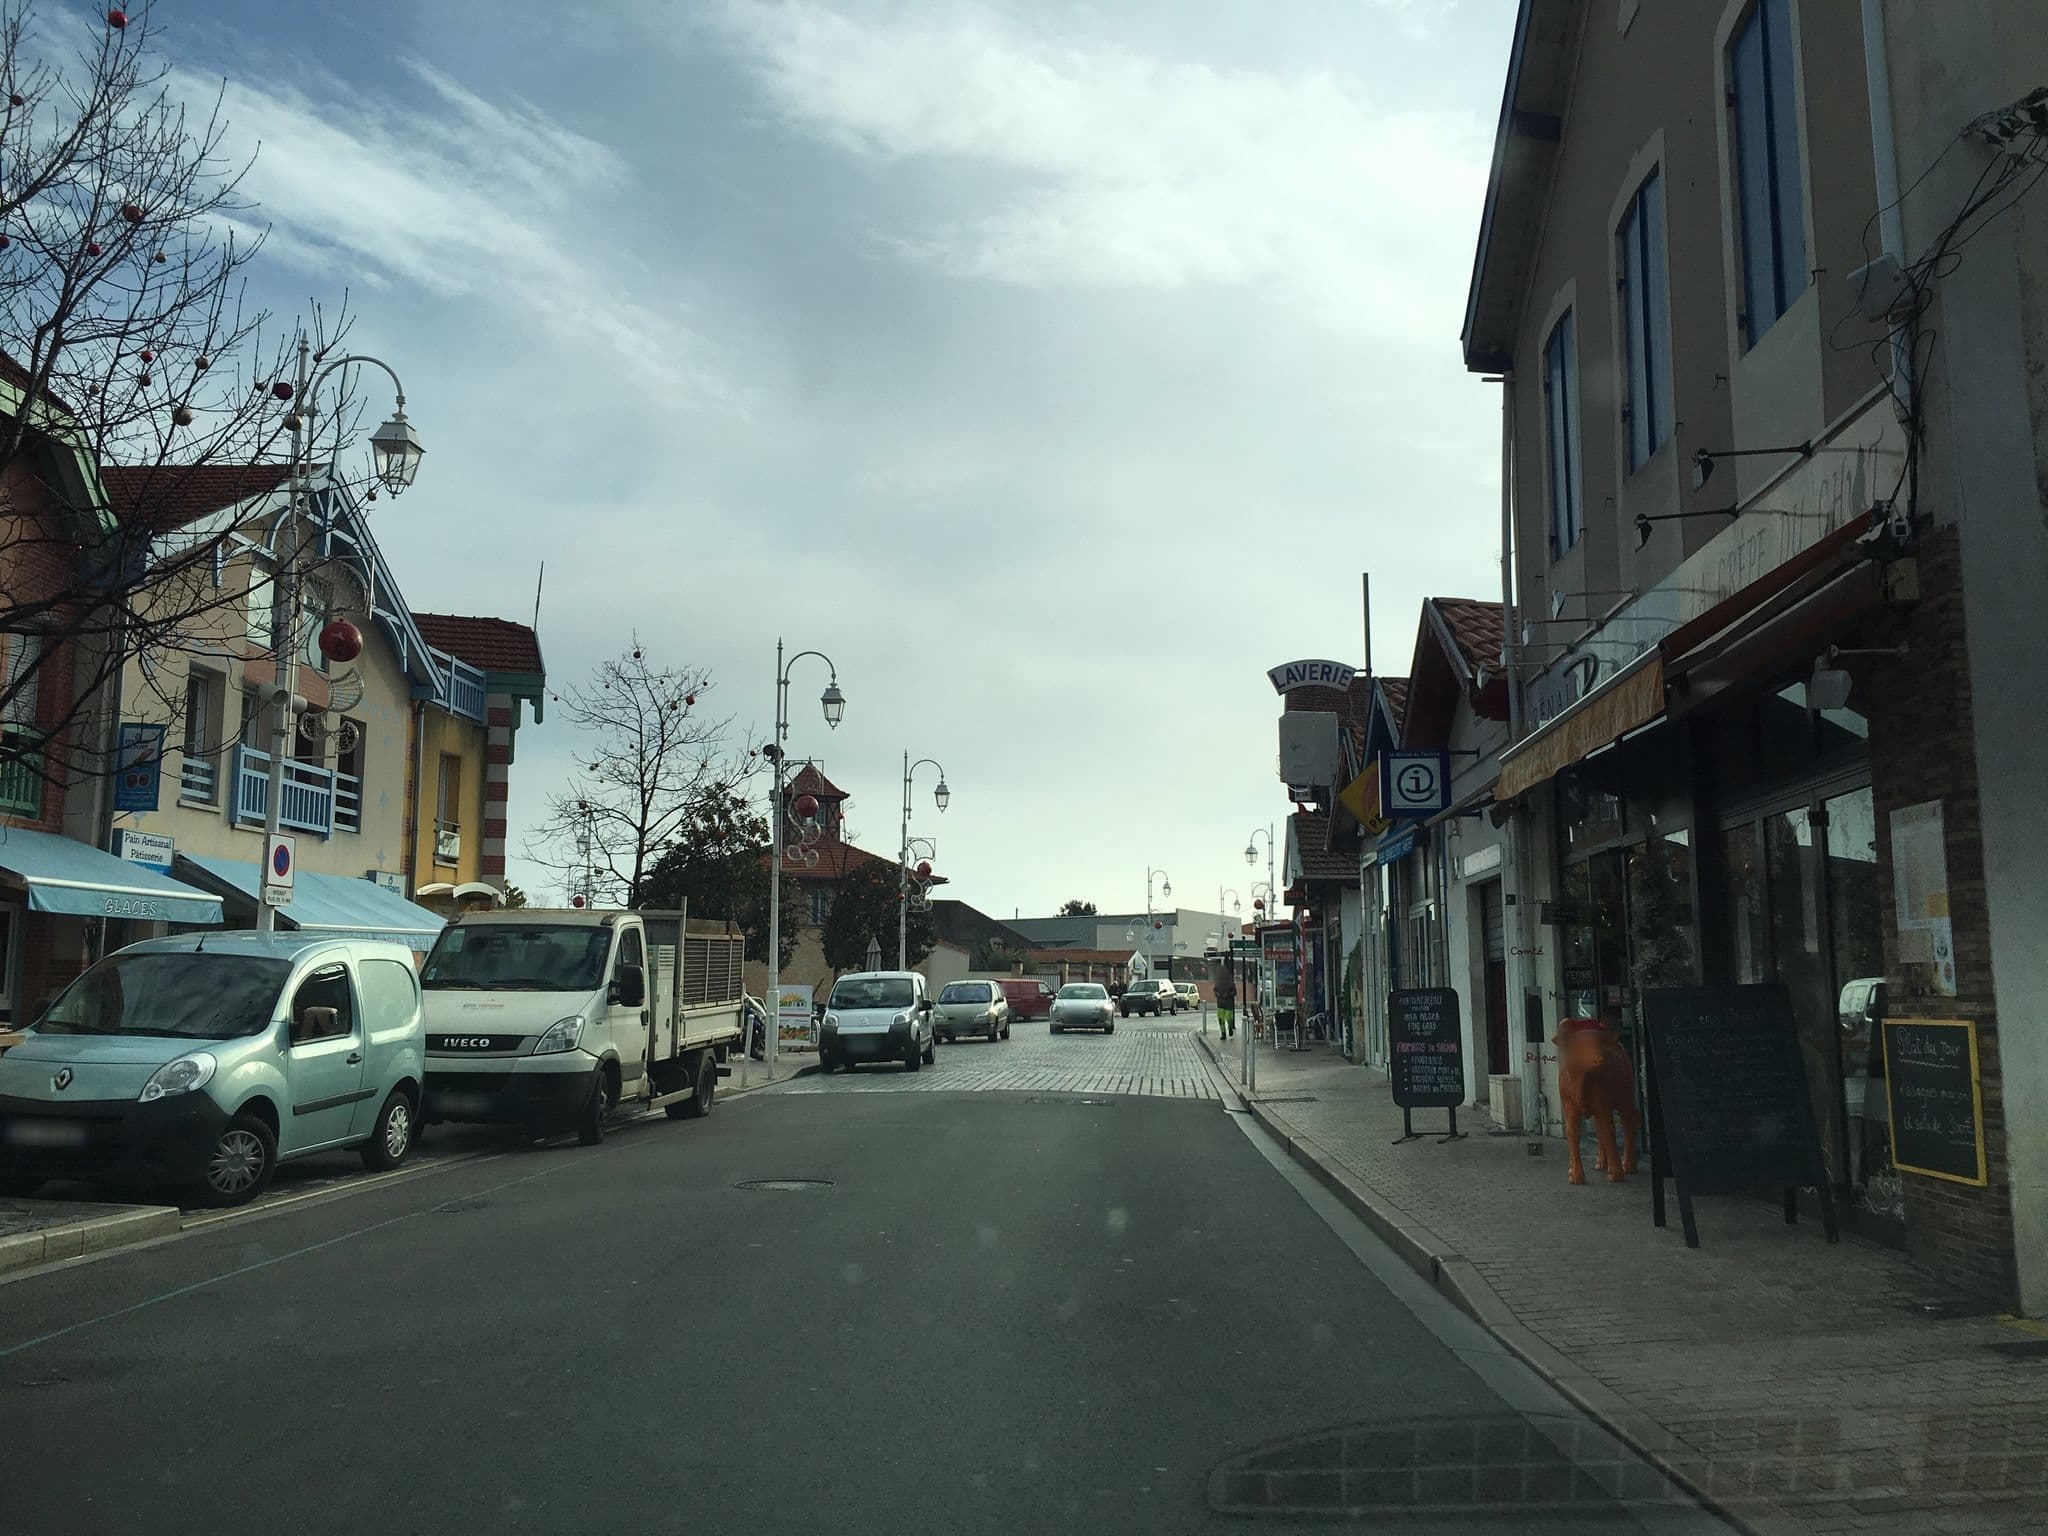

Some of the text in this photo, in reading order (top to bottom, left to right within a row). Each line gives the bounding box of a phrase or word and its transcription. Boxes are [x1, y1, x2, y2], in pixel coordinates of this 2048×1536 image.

[1271, 663, 1354, 689] LAVERIE
[124, 833, 172, 849] Pain Artisanal
[105, 898, 158, 917] GLACES
[1510, 945, 1544, 956] Comté
[443, 1037, 490, 1048] IVECO
